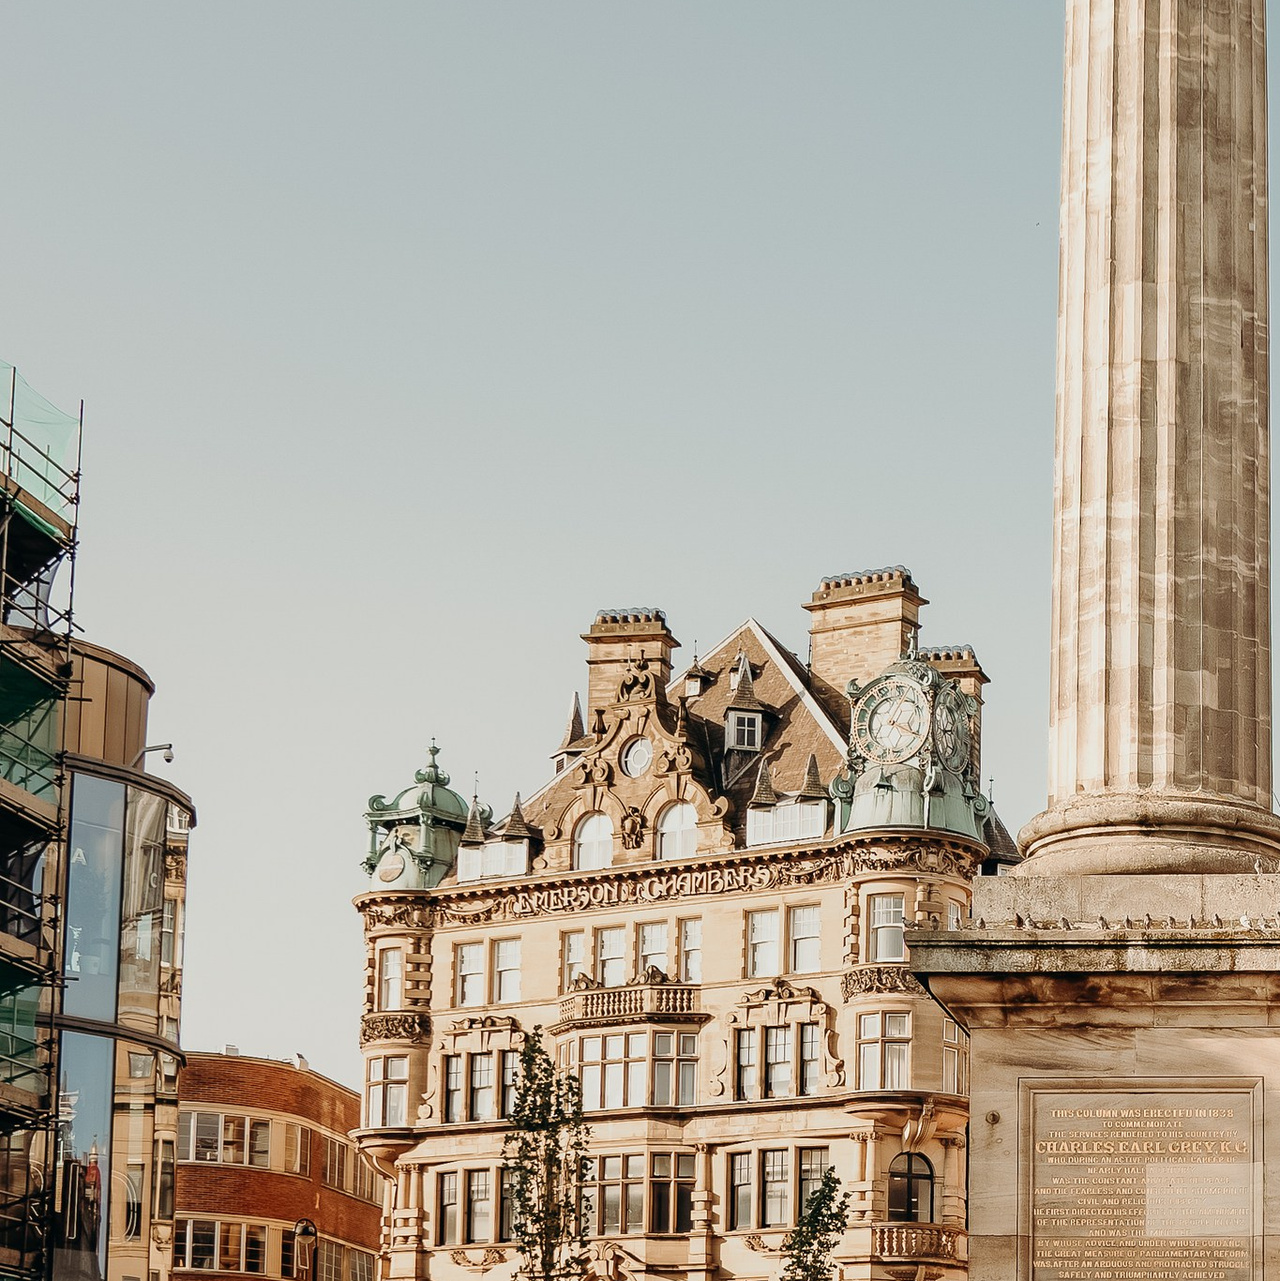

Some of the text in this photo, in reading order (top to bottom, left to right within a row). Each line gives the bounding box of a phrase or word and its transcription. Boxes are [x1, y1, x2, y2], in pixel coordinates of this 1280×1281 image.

[513, 864, 773, 914] EMERSON CHAMBERS
[1051, 1109, 1234, 1118] THIS COLUMN WAS ERECTED IN 1838
[1118, 1141, 1166, 1154] EARL
